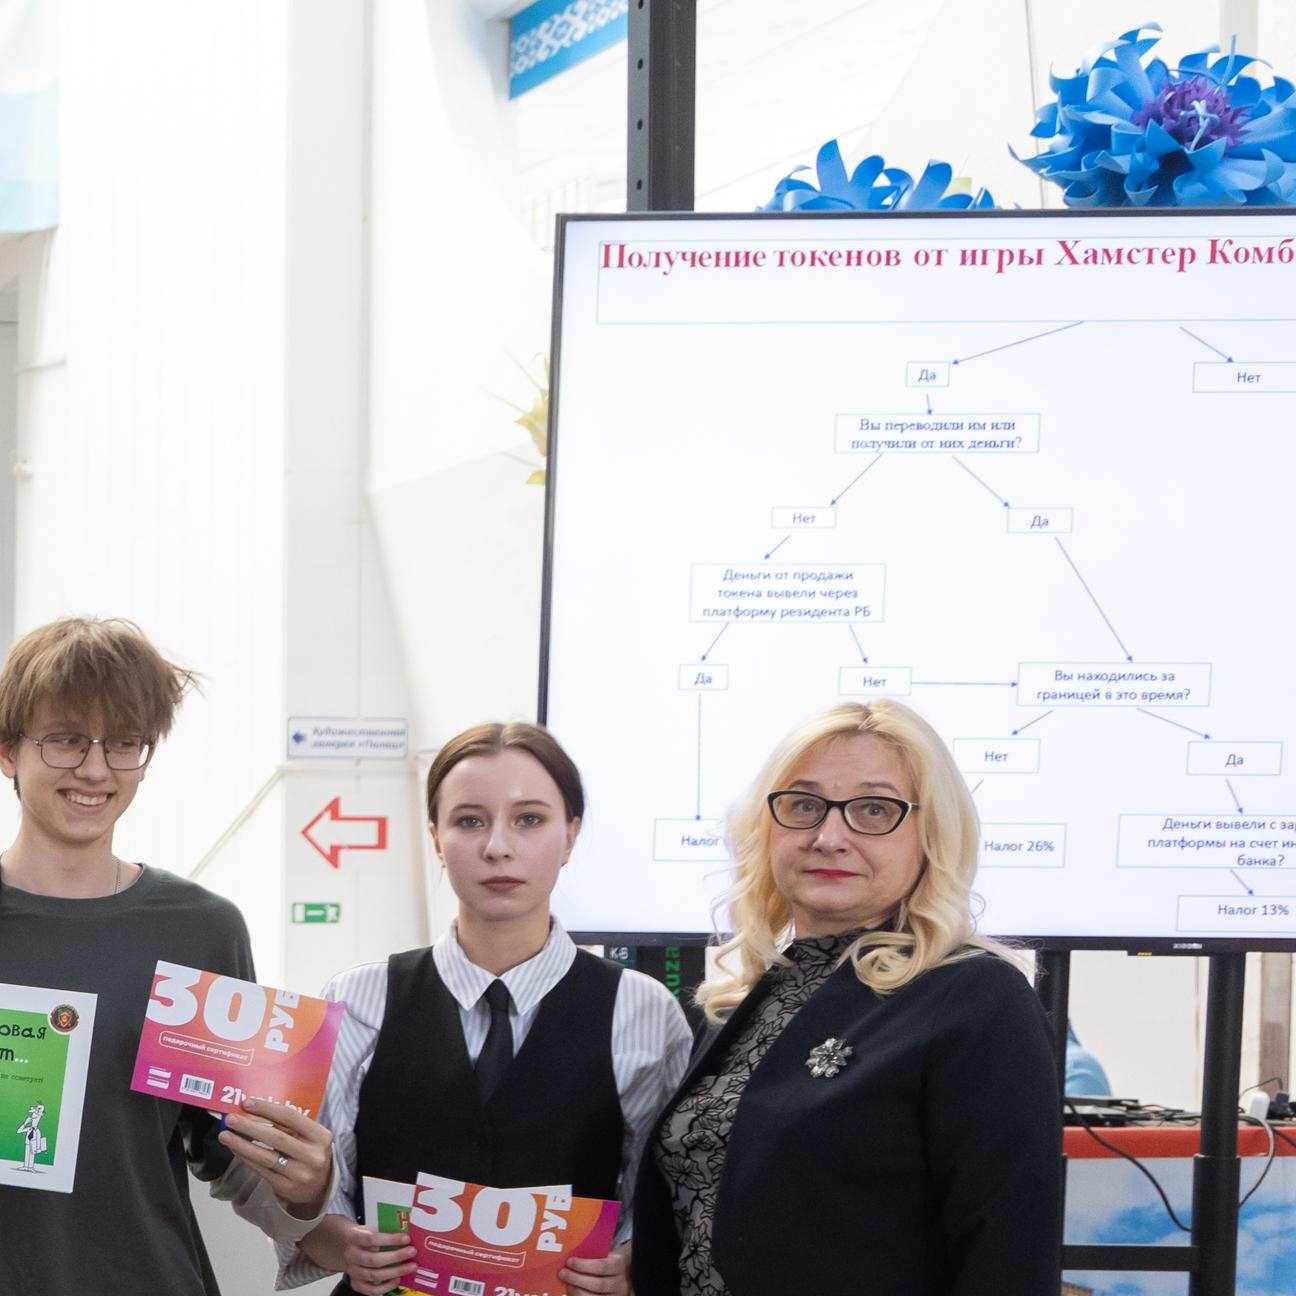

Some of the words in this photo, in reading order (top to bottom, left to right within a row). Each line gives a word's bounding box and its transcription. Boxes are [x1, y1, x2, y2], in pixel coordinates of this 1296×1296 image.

[602, 243, 767, 275] Получение
[773, 248, 902, 268] токенов
[913, 248, 949, 266] от
[959, 248, 1045, 274] игры
[1056, 239, 1197, 272] Хамстер
[917, 368, 937, 383] Да
[1236, 372, 1263, 384] Нет
[859, 418, 881, 431] Вы
[885, 420, 965, 433] переводили
[968, 421, 986, 431] им
[990, 421, 1016, 431] или
[851, 438, 917, 454] получили
[920, 440, 935, 450] от
[939, 439, 965, 450] них
[968, 436, 1023, 450] деньги?
[792, 513, 817, 524] Нет
[1030, 515, 1049, 529] Да
[722, 568, 772, 582] Деньги
[775, 571, 789, 581] от
[793, 571, 854, 583] продажи
[718, 589, 762, 599] токена
[766, 589, 816, 599] вывели
[819, 589, 858, 600] через
[702, 605, 777, 619] платформу
[780, 607, 851, 619] резидента
[854, 605, 871, 617] РБ
[694, 672, 713, 686] Да
[862, 676, 887, 687] Нет
[1054, 670, 1074, 681] Вы
[1077, 670, 1158, 683] находились
[1161, 672, 1176, 682] за
[1036, 688, 1101, 702] границей
[1105, 691, 1112, 700] в
[1116, 690, 1138, 700] это
[1141, 688, 1191, 703] время?
[984, 750, 1008, 762] Нет
[1224, 753, 1244, 767] Да
[1162, 817, 1212, 831] Деньги
[1215, 820, 1266, 830] вывели
[984, 840, 1024, 852] Налог
[1026, 840, 1056, 852] 26%
[1147, 836, 1227, 850] платформы
[1230, 840, 1246, 848] на
[1249, 840, 1278, 848] счет
[1237, 854, 1285, 866] банка?
[1217, 904, 1258, 916] Налог
[1261, 904, 1290, 916] 13%
[146, 960, 265, 1043] 30
[409, 1172, 537, 1247] 30
